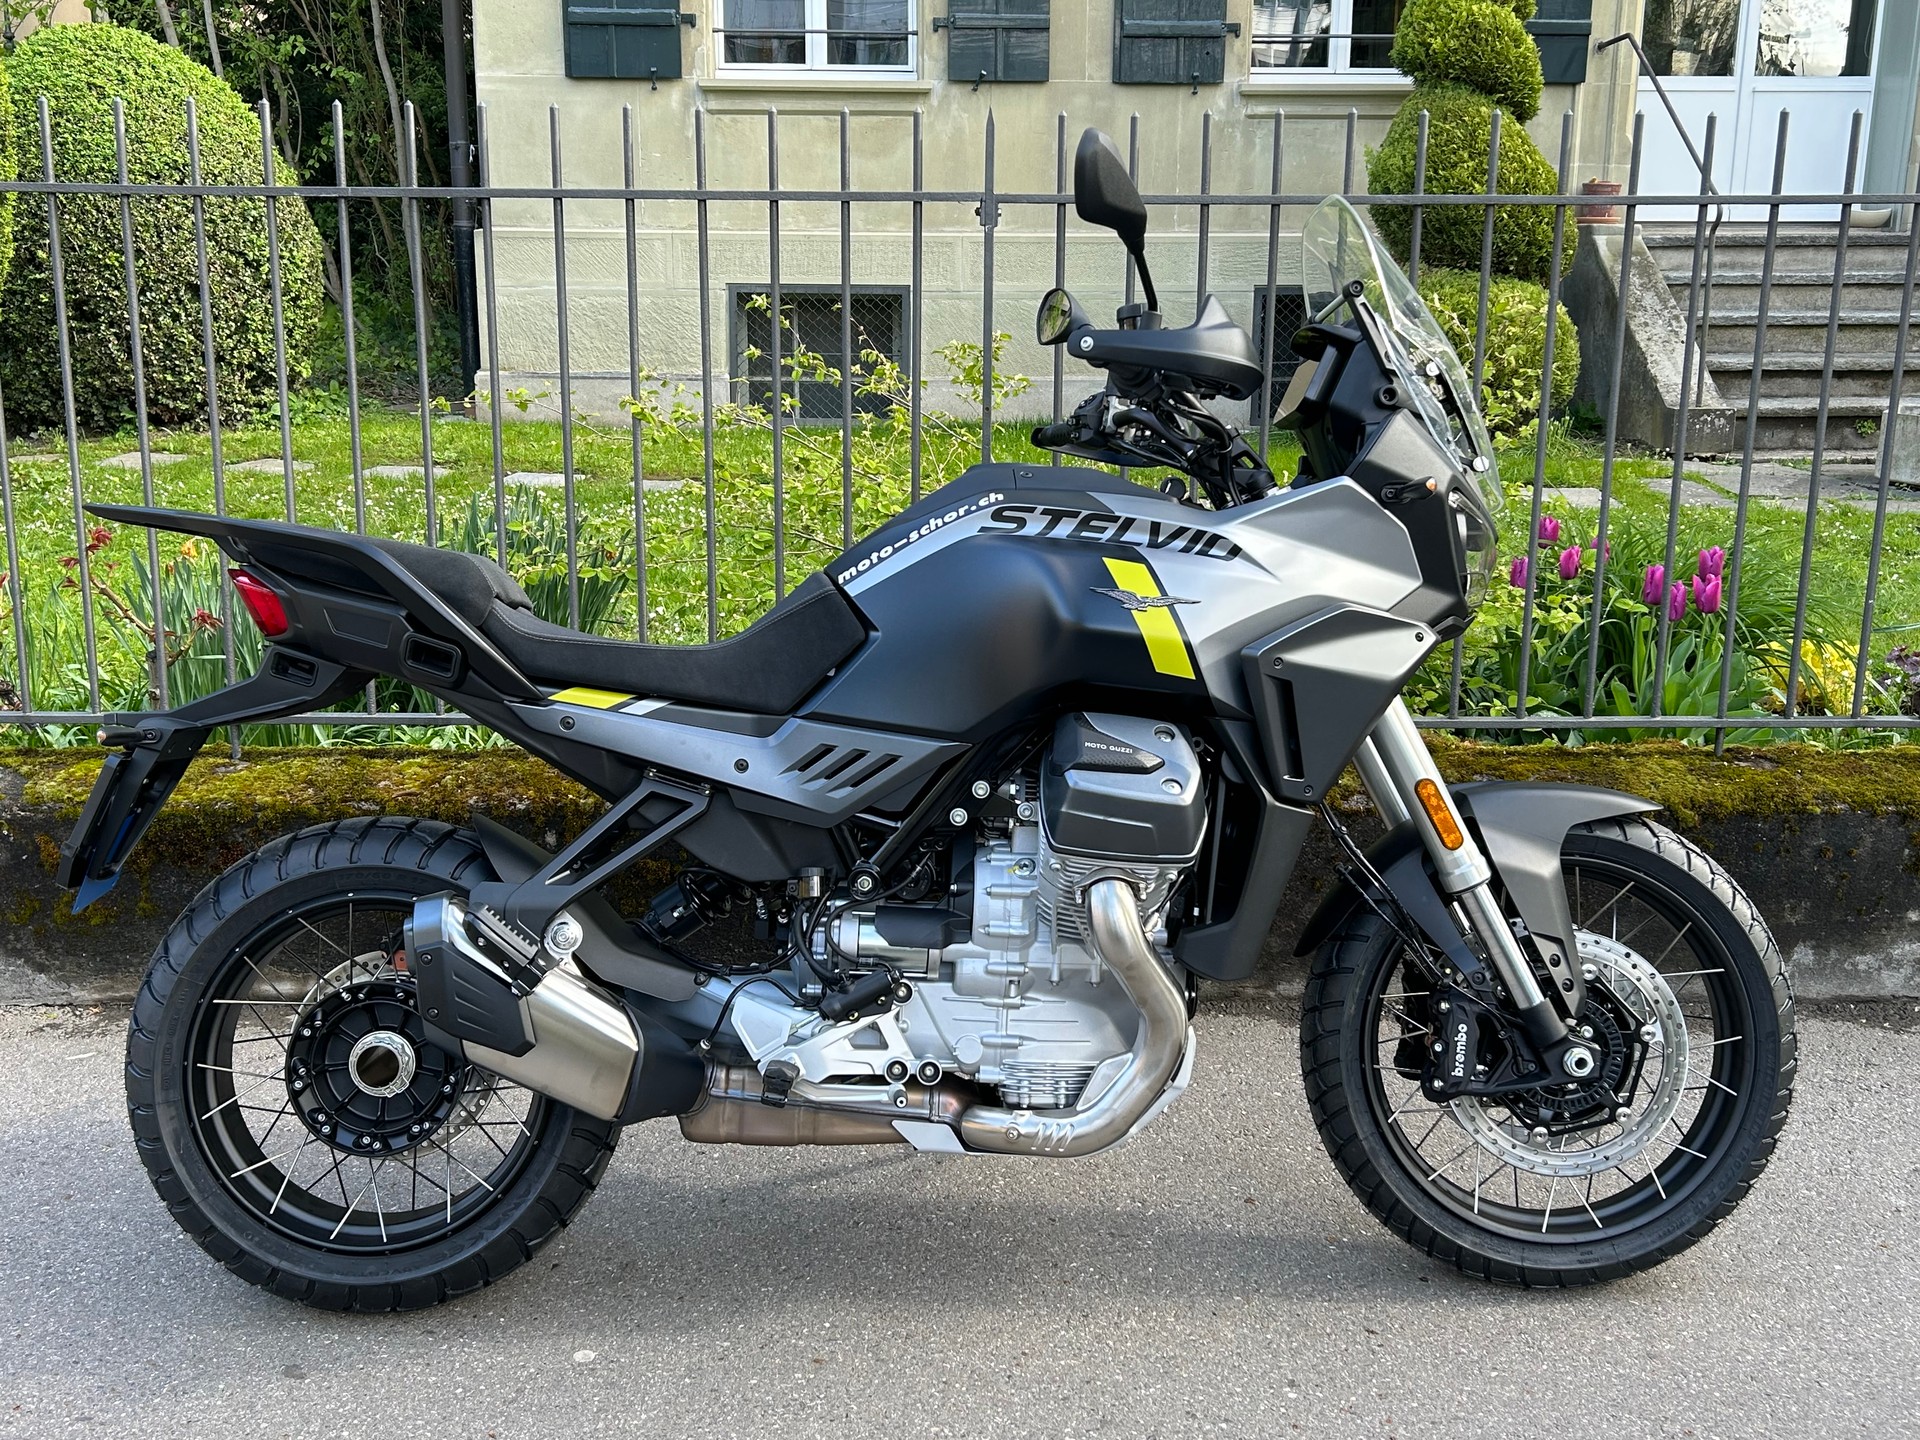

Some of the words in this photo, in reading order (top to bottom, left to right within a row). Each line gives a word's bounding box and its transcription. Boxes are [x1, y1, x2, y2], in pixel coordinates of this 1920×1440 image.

[837, 492, 1005, 585] moto-schor.ch
[976, 505, 1243, 562] STELVIO
[1084, 741, 1107, 750] MOTO
[1109, 745, 1133, 754] GUZZI
[1451, 1023, 1468, 1077] brembo
